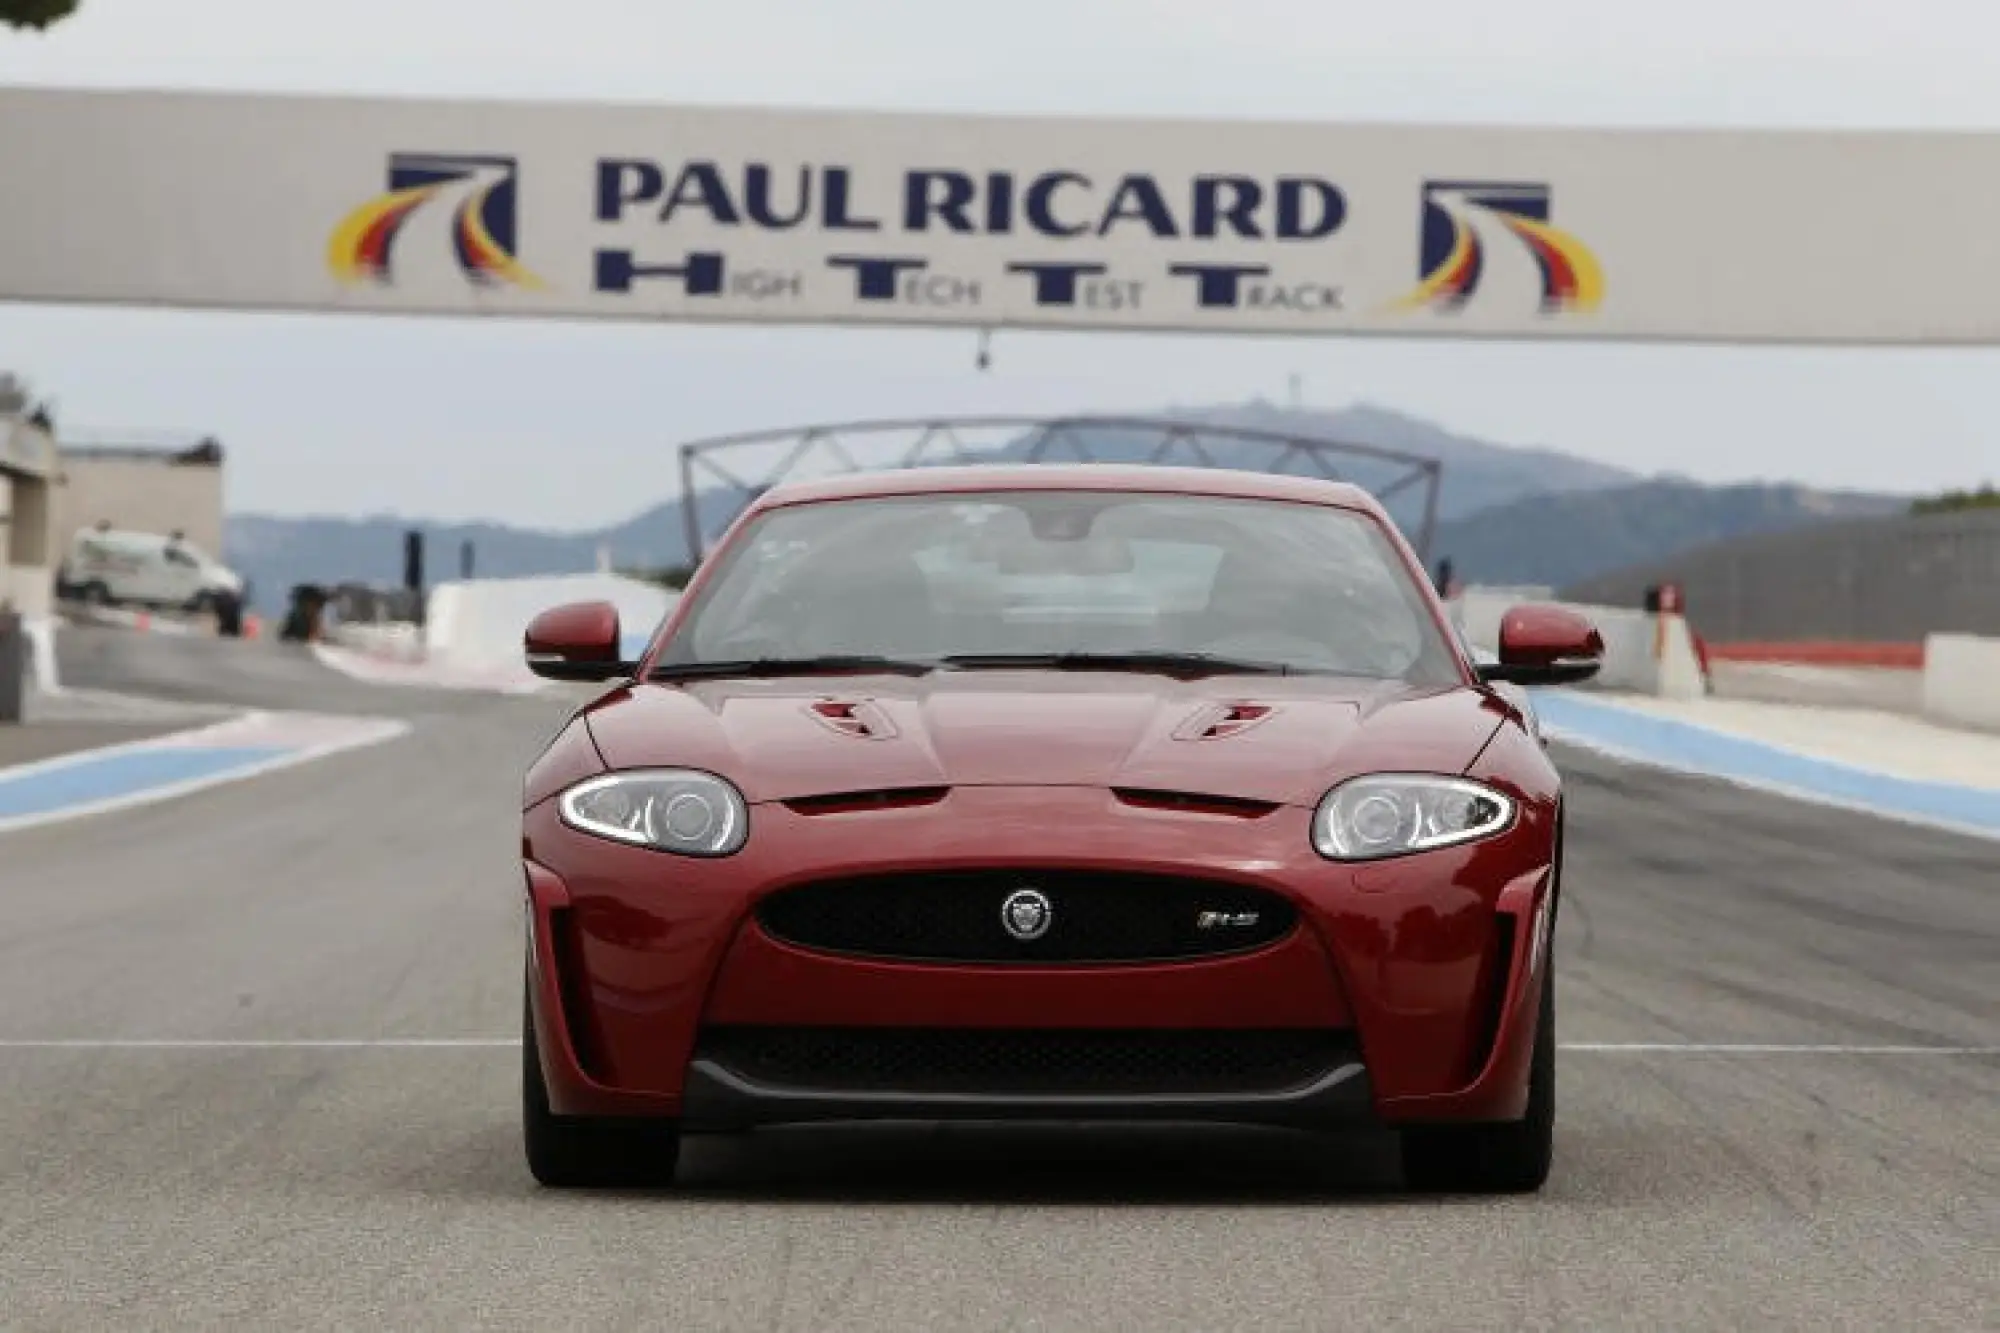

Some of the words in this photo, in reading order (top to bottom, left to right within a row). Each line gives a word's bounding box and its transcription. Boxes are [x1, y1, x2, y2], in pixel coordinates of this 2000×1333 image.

[596, 158, 880, 230] PAUL
[904, 168, 1347, 241] RICARD
[1005, 262, 1143, 309] TEST
